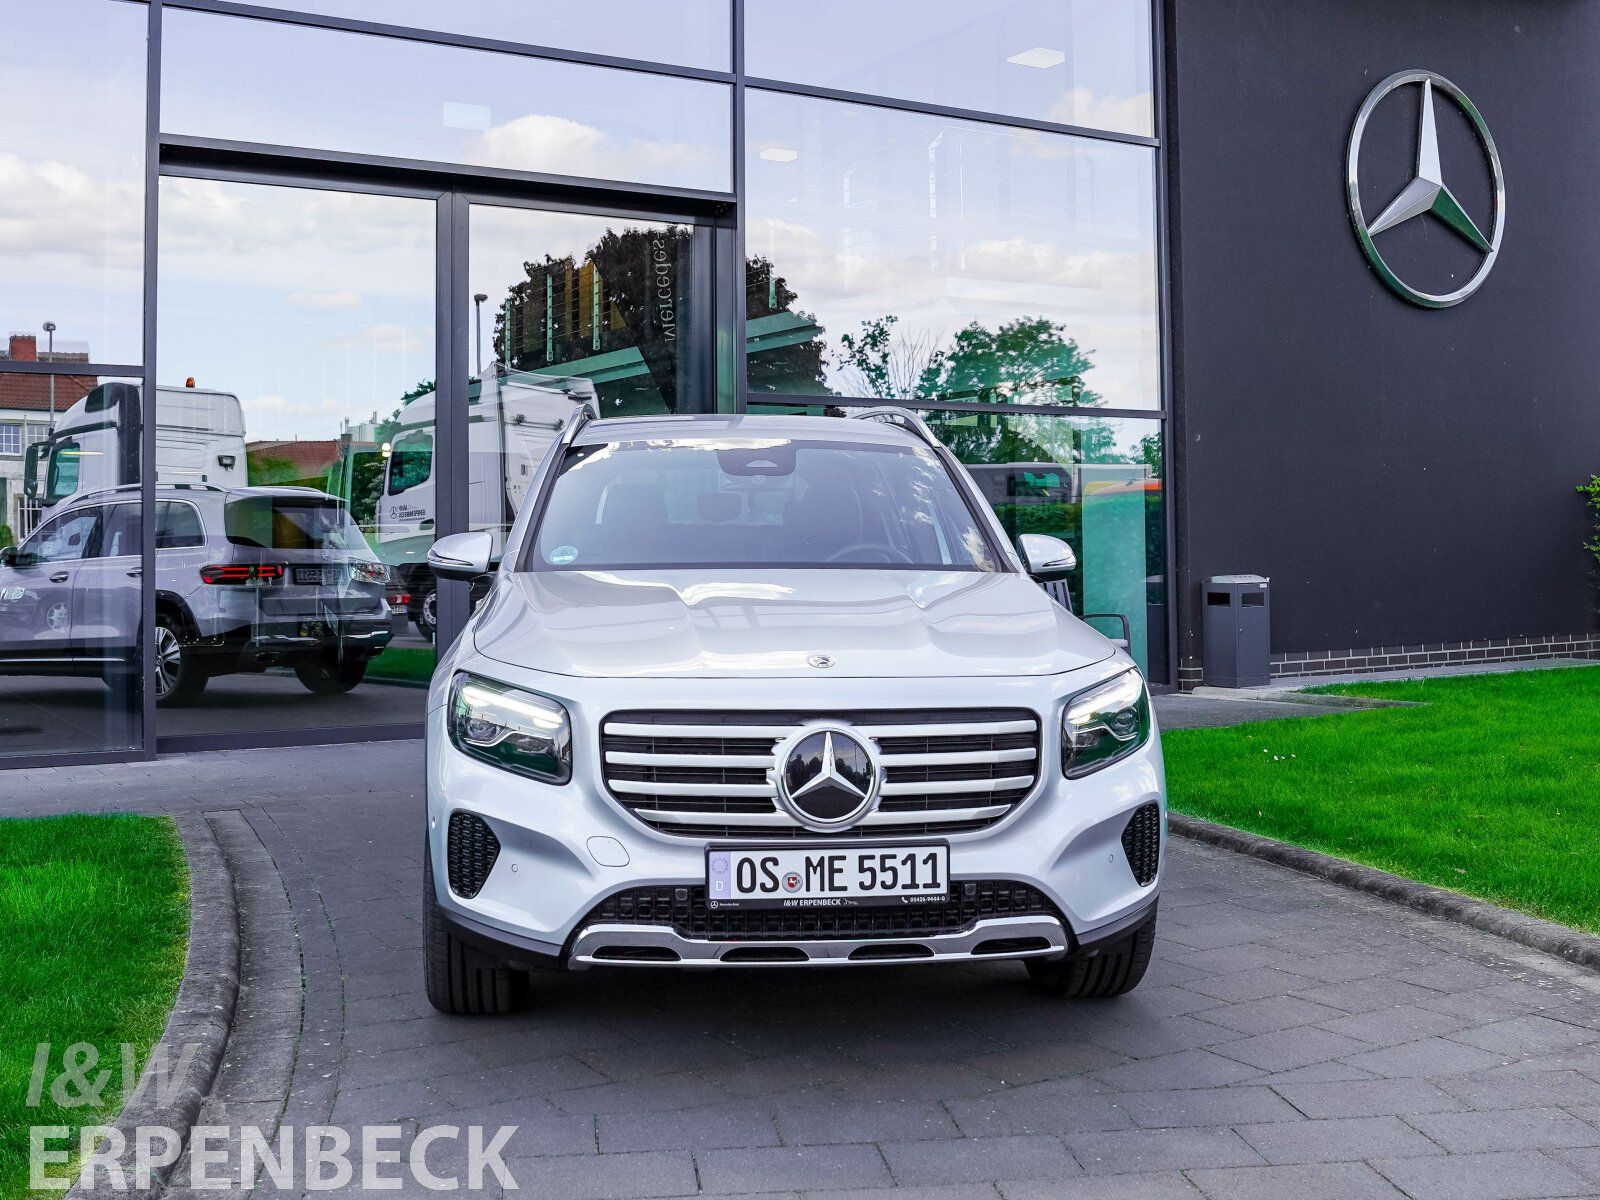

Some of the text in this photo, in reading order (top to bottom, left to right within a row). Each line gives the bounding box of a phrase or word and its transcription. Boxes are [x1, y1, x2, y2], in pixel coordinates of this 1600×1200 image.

[736, 856, 780, 894] OS
[805, 854, 848, 892] ME
[858, 852, 941, 891] 5511
[715, 880, 724, 891] D
[783, 899, 799, 907] I&W
[799, 898, 842, 907] ERPENBECK
